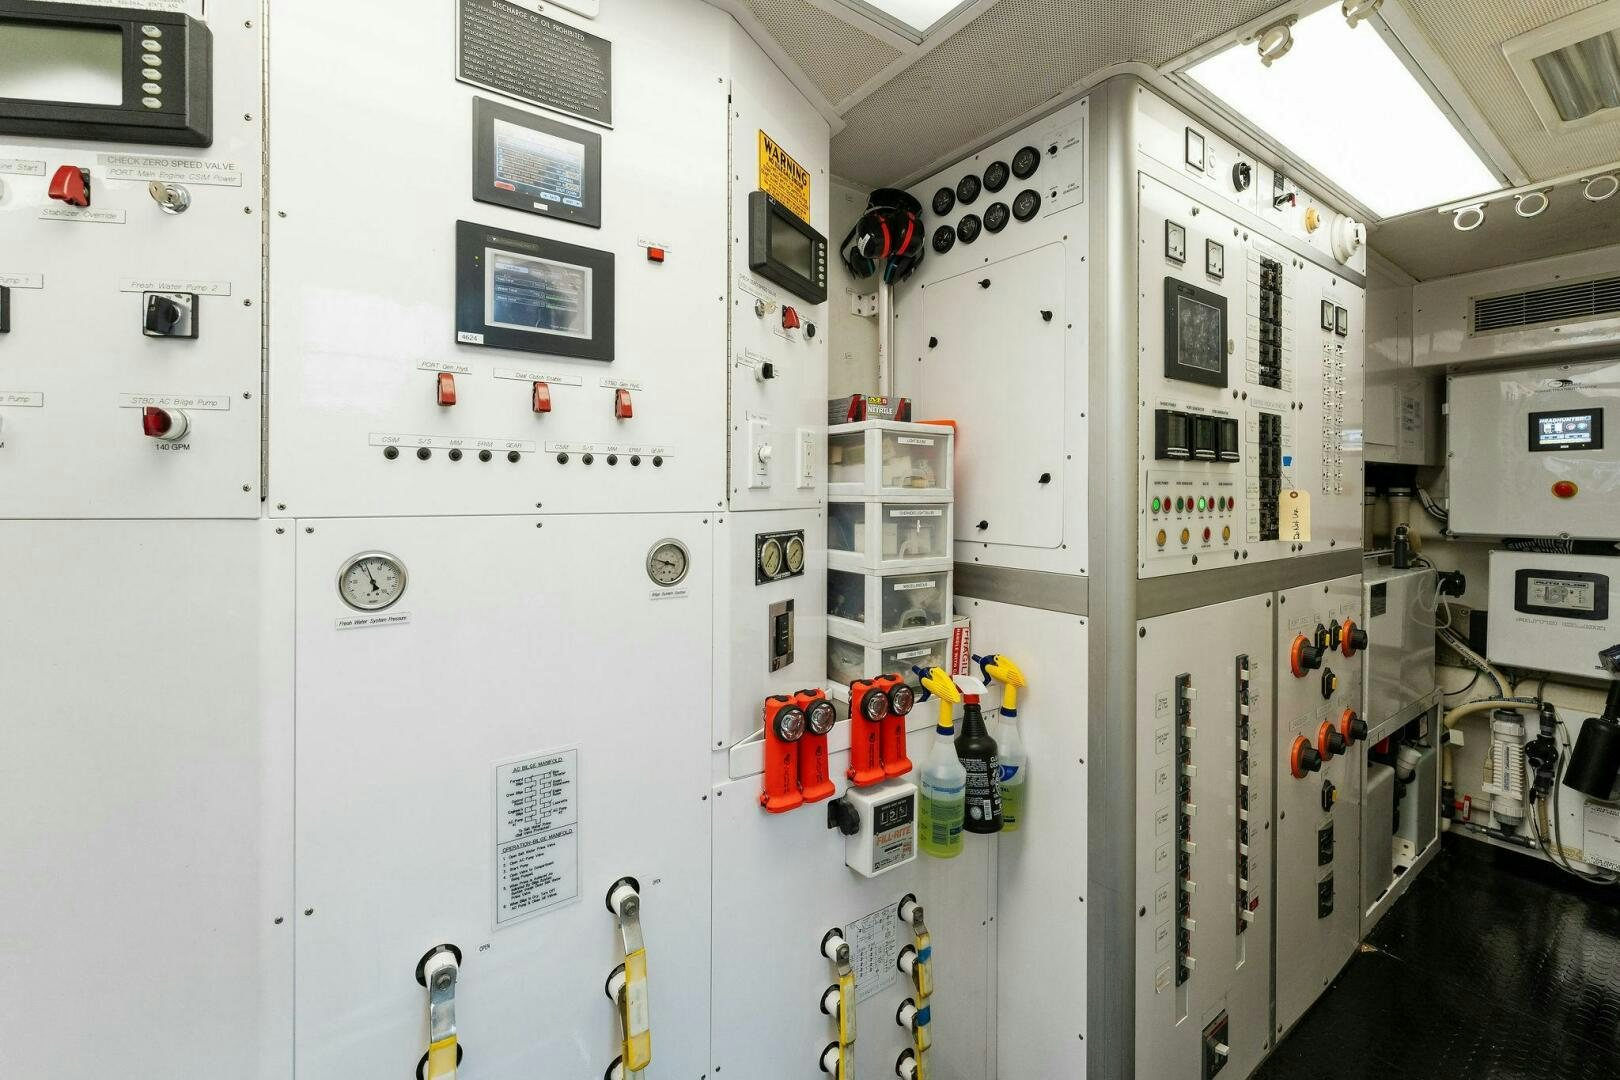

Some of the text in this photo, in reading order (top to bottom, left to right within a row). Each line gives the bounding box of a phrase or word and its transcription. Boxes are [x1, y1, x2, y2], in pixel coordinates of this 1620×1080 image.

[493, 1, 585, 41] DISCHARGE OF OIL PROHIBITED
[107, 155, 235, 171] CHECK ZERO SPEED VALVE
[764, 136, 807, 187] WARNING
[110, 168, 134, 176] PORT
[140, 169, 156, 177] Main
[160, 171, 185, 180] Engine
[41, 208, 117, 219] Stabilizer Override
[131, 281, 154, 289] Fresh
[159, 282, 182, 290] Water
[186, 284, 208, 292] Pump
[461, 333, 478, 341] 4624
[421, 361, 440, 369] PORT
[131, 397, 154, 405] STBD
[174, 399, 193, 407] Bilge
[197, 399, 218, 407] Pump
[868, 406, 893, 415] NITRILE
[961, 630, 969, 676] FRAGIL
[521, 762, 535, 770] BILGE
[538, 756, 562, 766] MANIFOLD
[548, 829, 572, 840] MANIFOLD
[479, 944, 490, 952] OPEN
